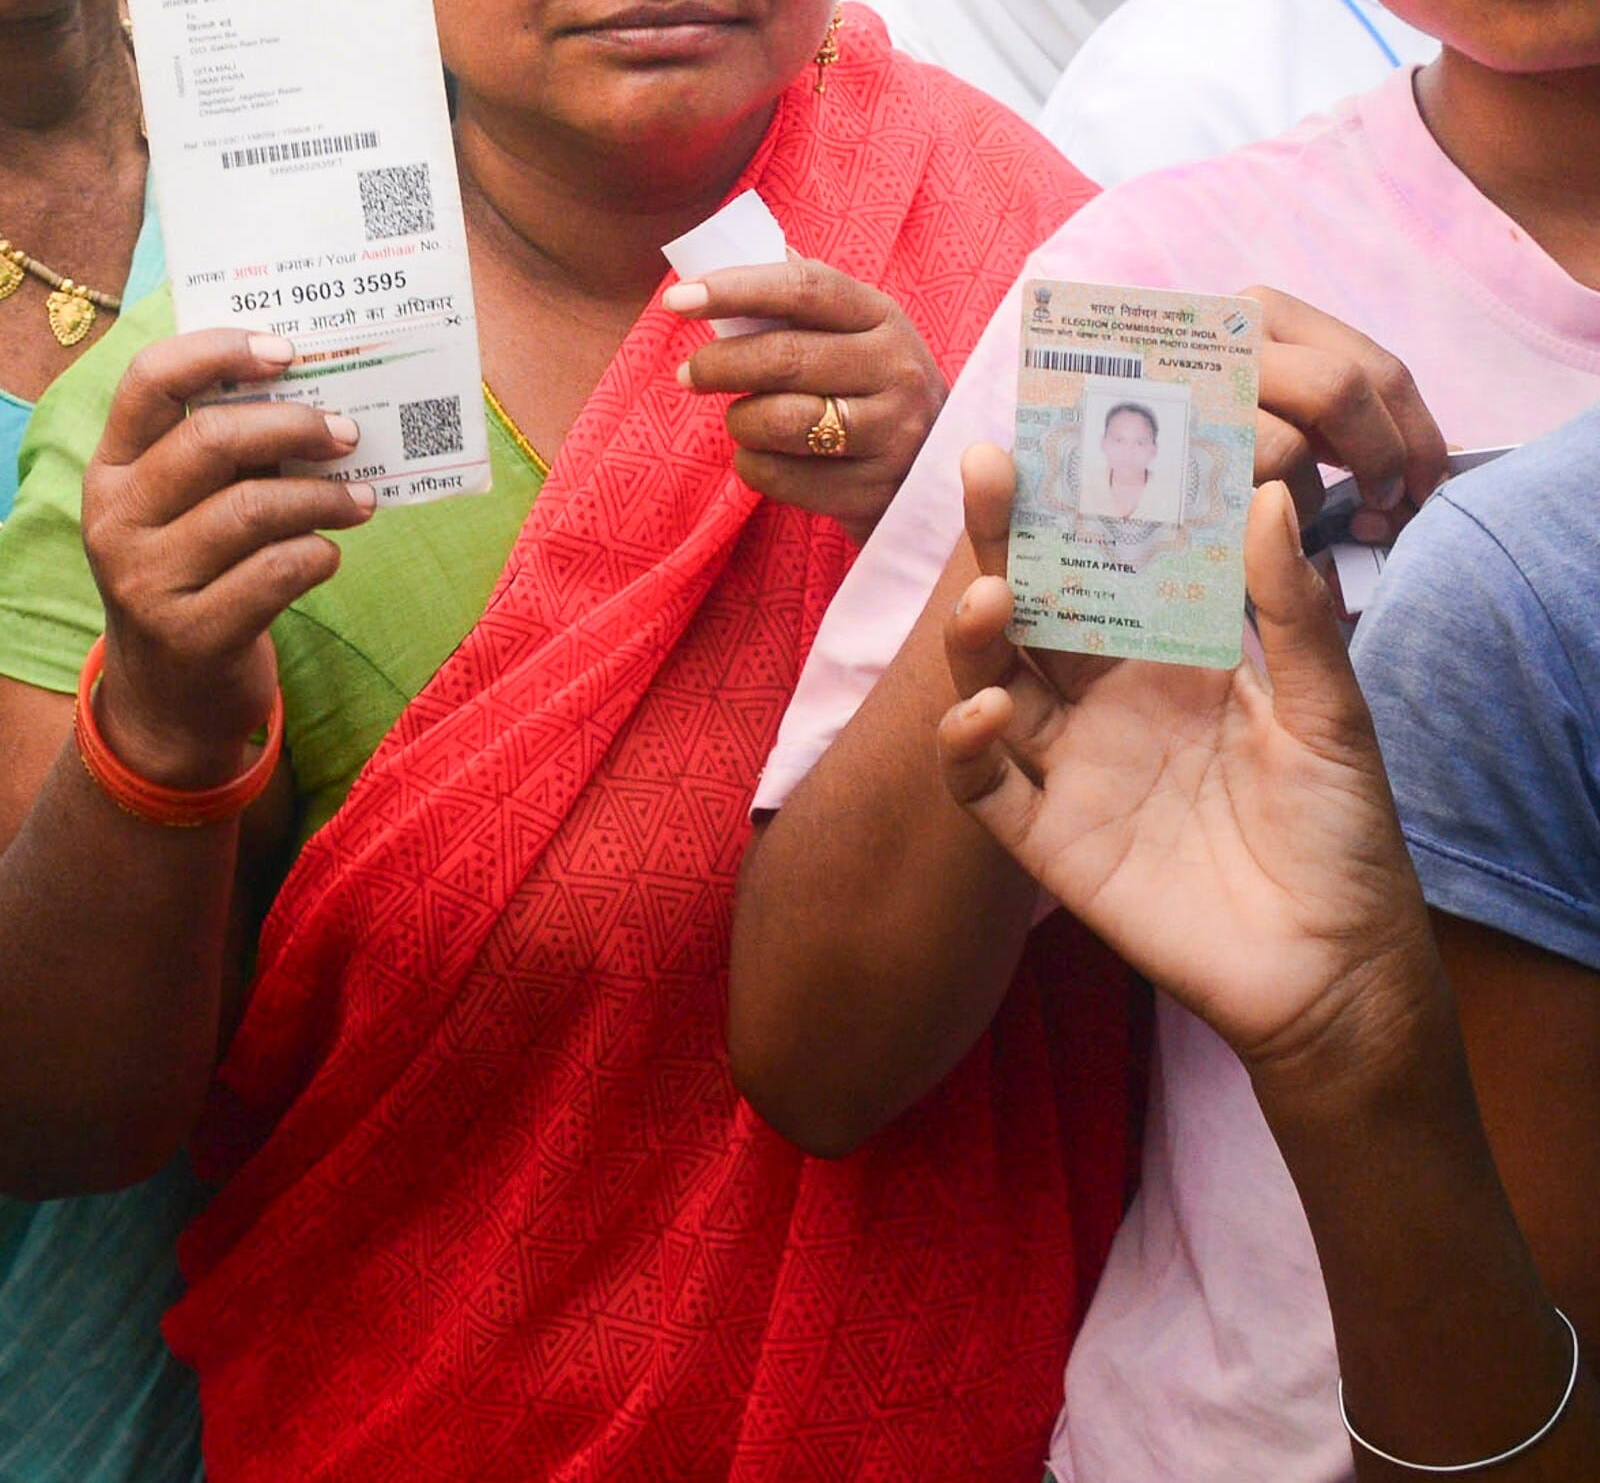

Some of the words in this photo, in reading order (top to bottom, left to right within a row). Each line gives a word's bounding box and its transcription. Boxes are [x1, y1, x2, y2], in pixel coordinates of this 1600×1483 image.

[186, 269, 226, 288] आपका
[234, 263, 272, 281] आधार
[325, 252, 358, 268] Your
[361, 244, 417, 263] Aadhaar
[230, 288, 284, 314] 3621
[291, 279, 347, 305] 9603
[353, 269, 409, 296] 3595
[309, 308, 358, 330] आदमी
[366, 307, 386, 322] का
[394, 295, 455, 319] अधिकार
[1090, 303, 1116, 316] भारत
[1120, 303, 1158, 321] निर्वाचन
[1061, 316, 1109, 330] ELECTION
[1111, 320, 1173, 336] COMMISSION
[1175, 326, 1188, 337] OF
[1190, 328, 1218, 340] INDIA
[1160, 339, 1188, 350] PHOTO
[354, 464, 387, 480] 3595
[381, 485, 401, 498] का
[408, 475, 464, 497] अधिकार
[1060, 557, 1100, 571] SUNITA
[1102, 561, 1137, 575] PATEL
[1056, 610, 1106, 625] NARSING
[1109, 617, 1144, 629] PATEL
